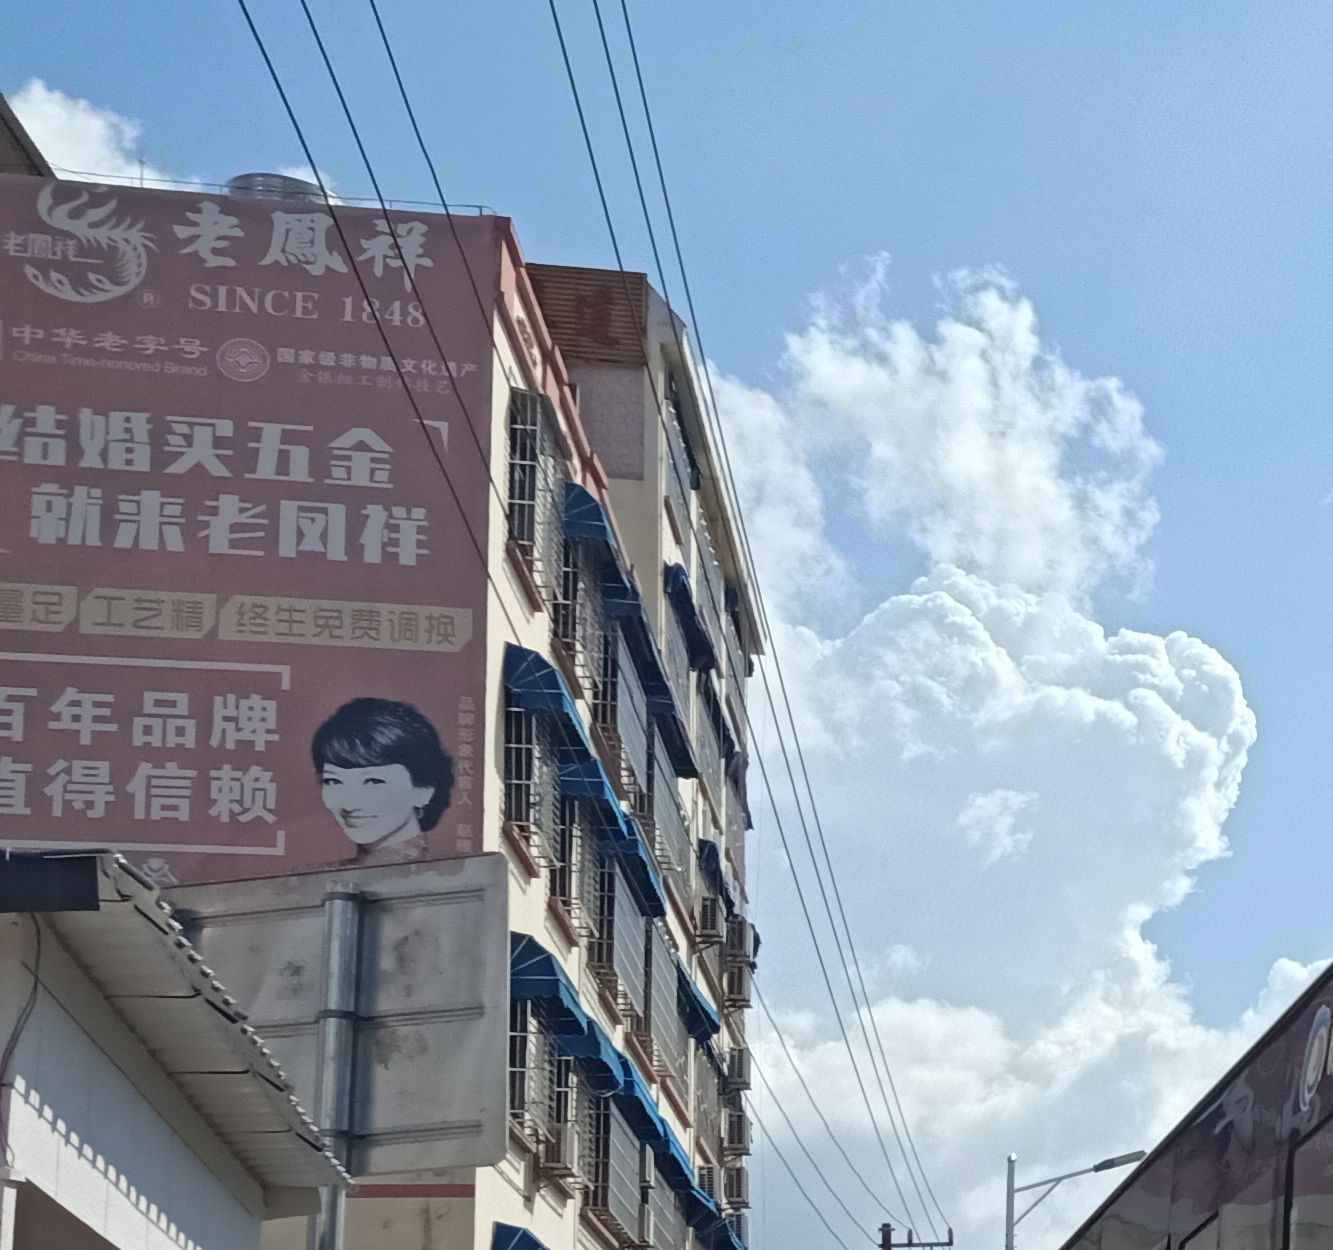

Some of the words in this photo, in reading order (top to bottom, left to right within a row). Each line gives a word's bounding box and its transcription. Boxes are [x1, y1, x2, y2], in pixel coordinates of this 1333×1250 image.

[172, 200, 434, 293] 老鳳祥
[187, 283, 319, 320] SINCE
[341, 295, 425, 328] 1848
[11, 323, 208, 358] 中华老字号
[0, 403, 395, 489] 结婚买五金
[29, 483, 430, 566] 就来老凤祥
[92, 593, 205, 634] 工艺精
[235, 600, 457, 648] 终生免费调换
